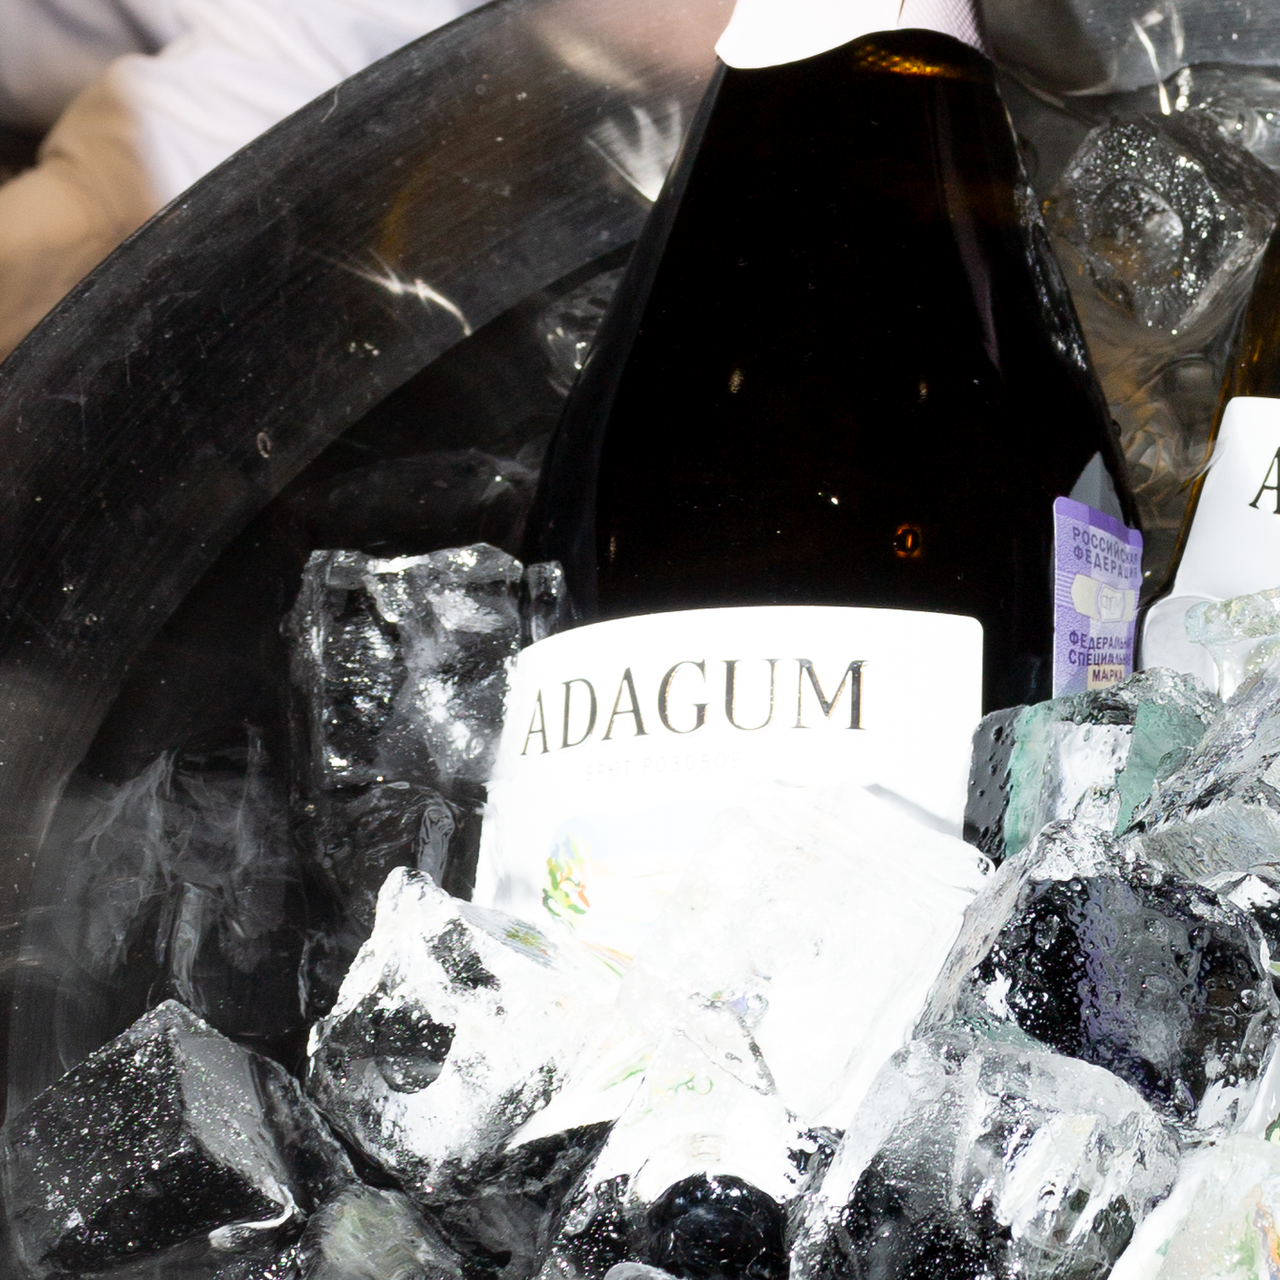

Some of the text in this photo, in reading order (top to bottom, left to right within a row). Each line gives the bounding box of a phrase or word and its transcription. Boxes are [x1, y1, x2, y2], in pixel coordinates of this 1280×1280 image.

[1072, 526, 1138, 565] РОССИЙСКАЯ
[1073, 544, 1138, 580] ФЕДЕРАЦИЯ
[520, 657, 869, 757] ADAGUM
